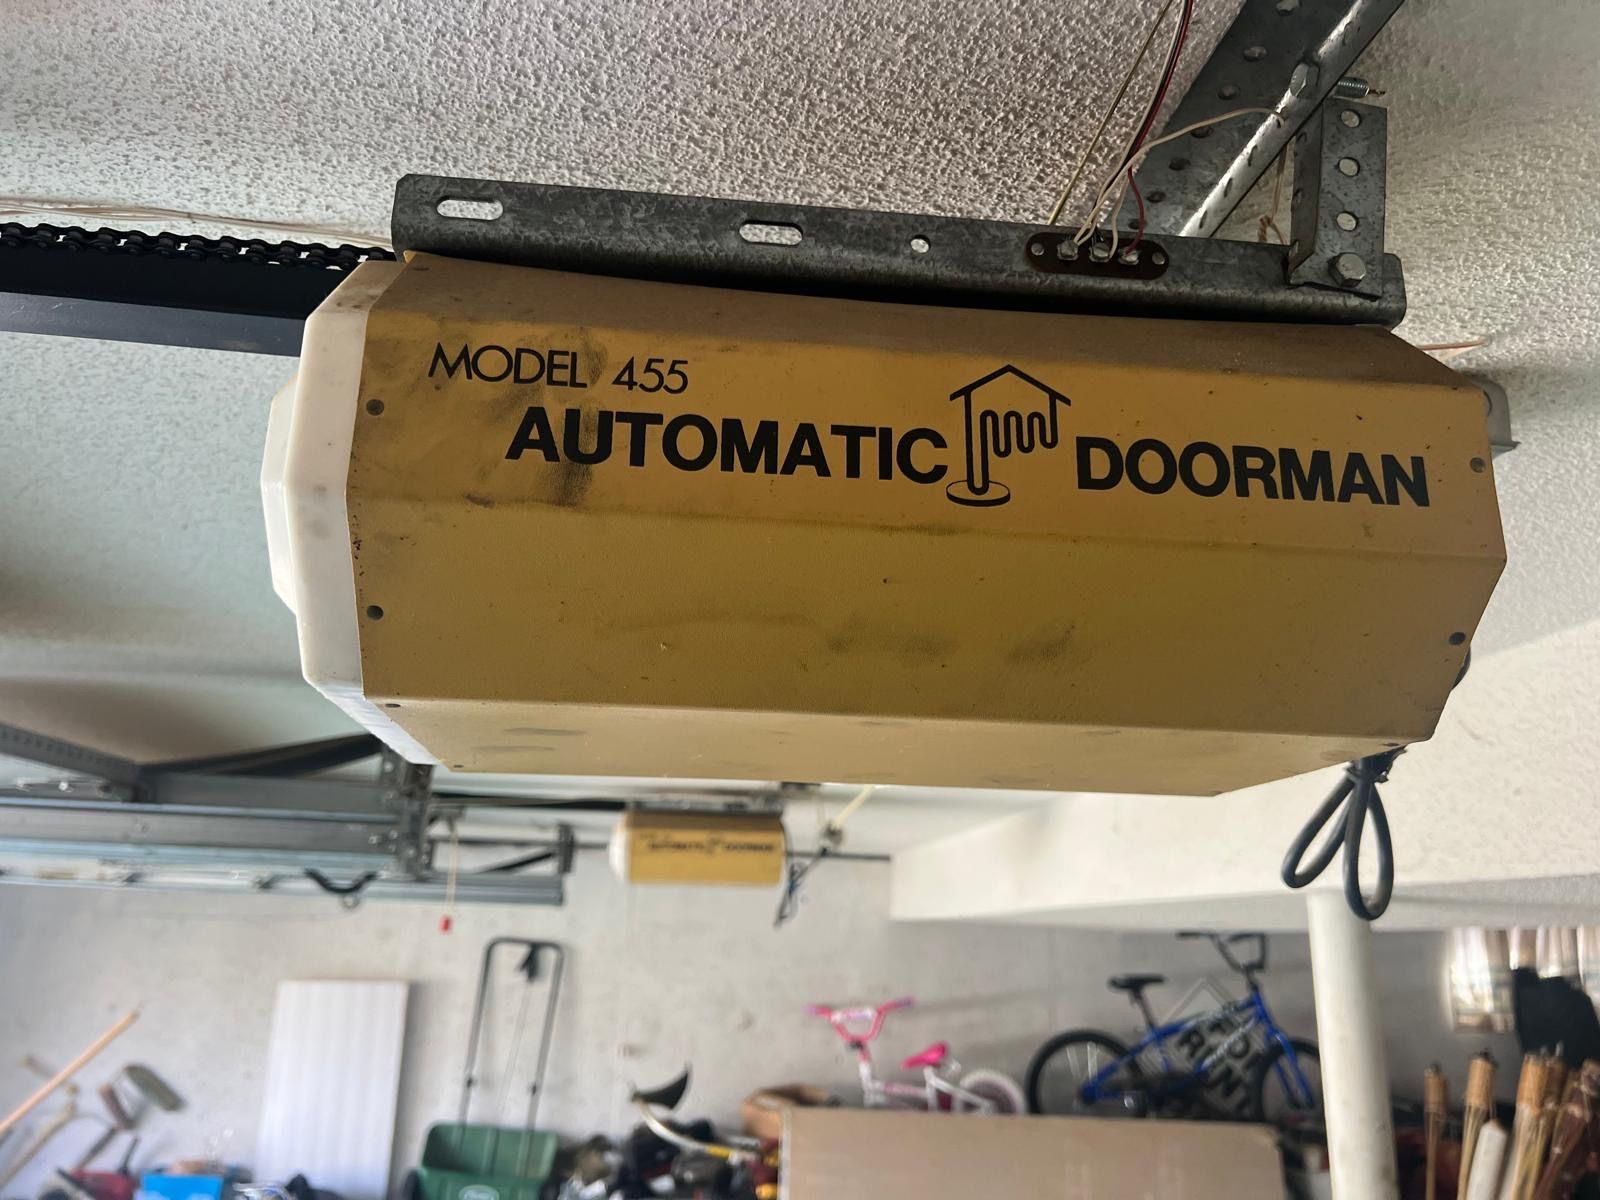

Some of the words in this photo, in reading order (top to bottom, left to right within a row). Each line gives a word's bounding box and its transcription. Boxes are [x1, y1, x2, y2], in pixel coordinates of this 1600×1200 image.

[428, 342, 588, 388] MODEL
[611, 356, 690, 394] 455
[504, 406, 949, 485] AUTOMATIC
[1075, 436, 1431, 507] DOORMAN
